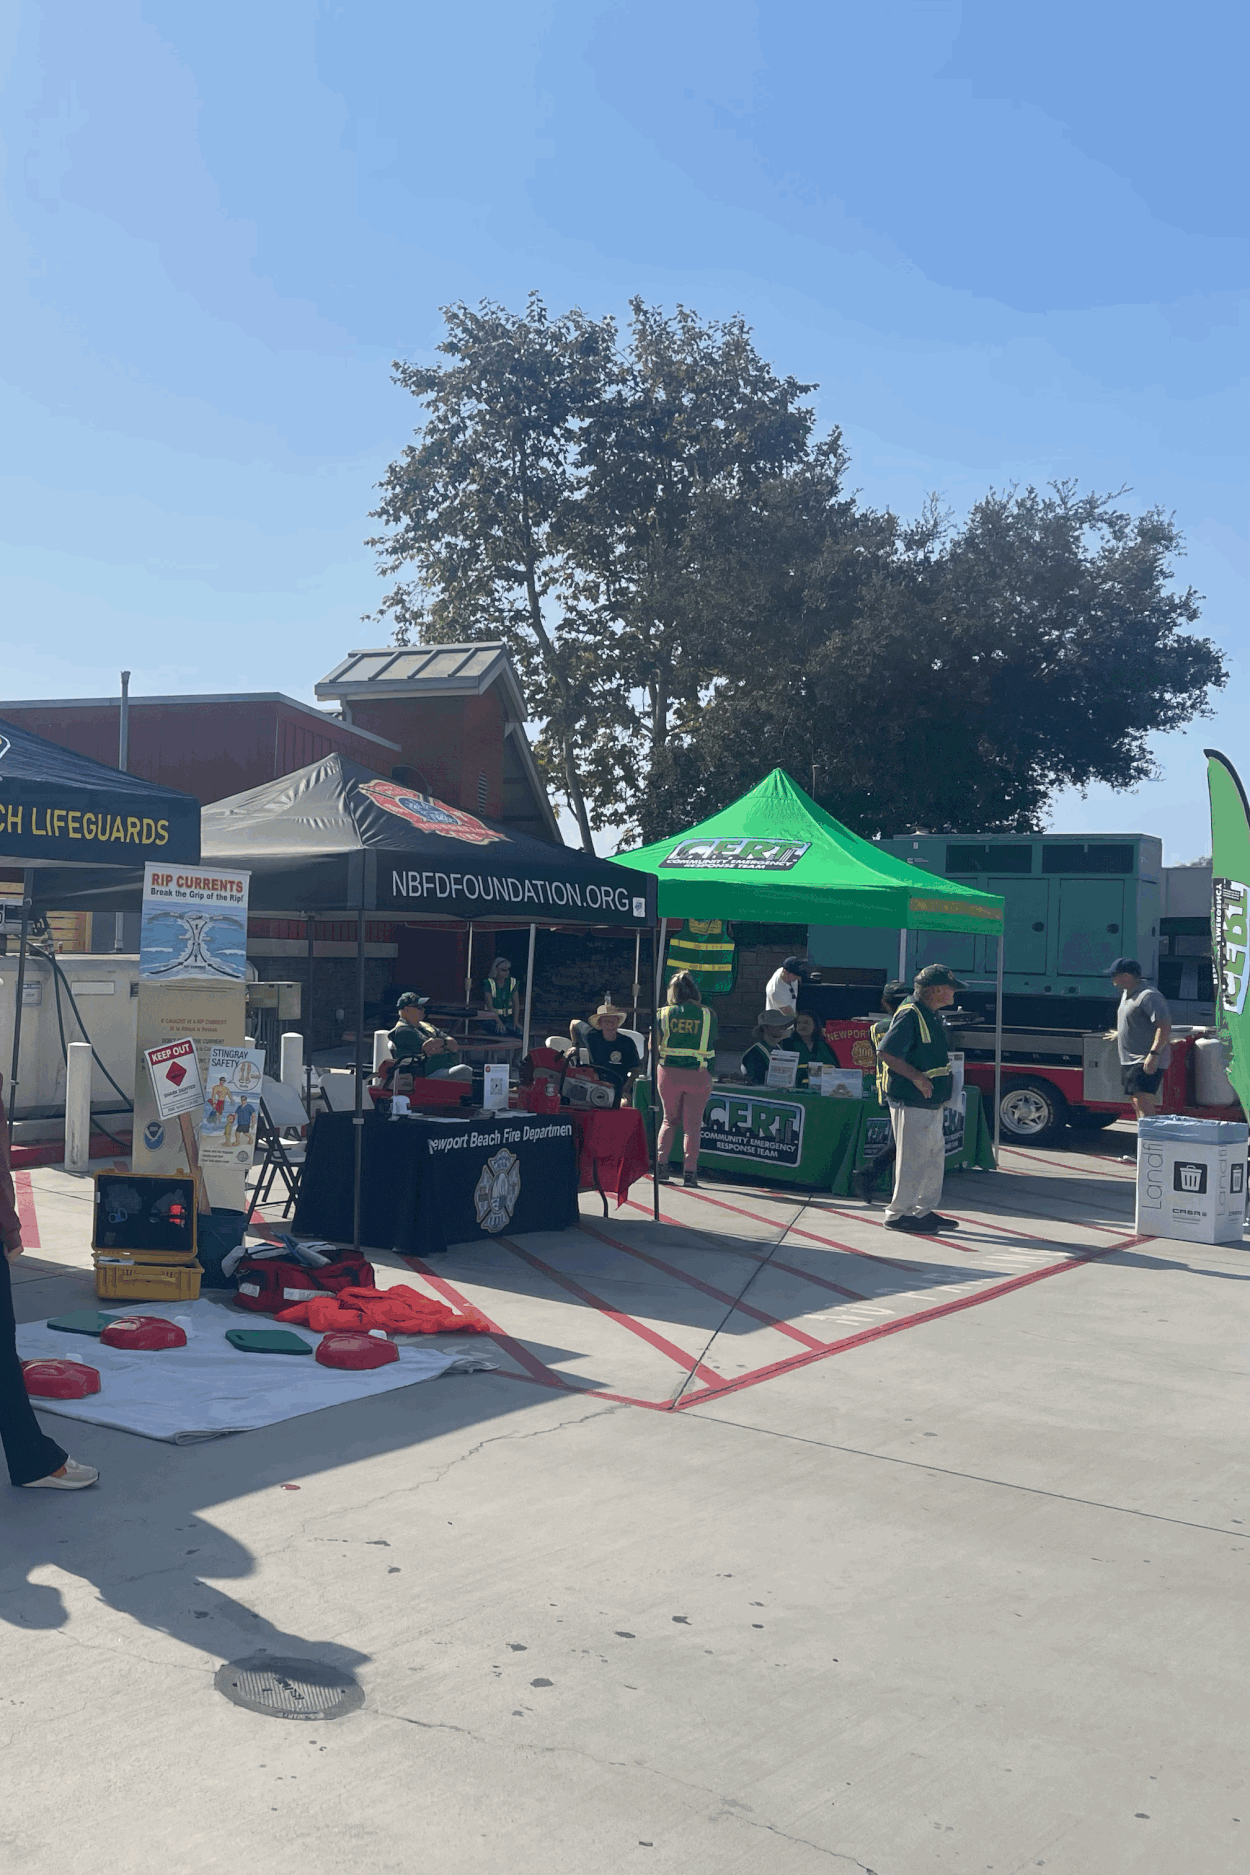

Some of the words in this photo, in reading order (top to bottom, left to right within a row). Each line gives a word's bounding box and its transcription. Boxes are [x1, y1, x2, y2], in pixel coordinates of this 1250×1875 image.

[31, 807, 169, 846] LIFEGUARDS
[676, 839, 806, 860] CERT
[730, 859, 794, 867] EMERGENCY
[151, 872, 174, 887] RIP
[176, 875, 244, 893] CURRENTS
[392, 870, 630, 912] NBFDFOUNDATION.ORG
[150, 887, 173, 897] Break
[175, 889, 187, 898] the
[189, 890, 205, 900] Grip
[206, 892, 214, 900] of
[216, 893, 228, 901] the
[670, 1018, 701, 1034] CERT
[151, 1049, 172, 1063] KEEP
[172, 1043, 190, 1056] OUT
[211, 1058, 240, 1068] SAFETY
[212, 1048, 249, 1060] STINGRAY
[702, 1098, 797, 1141] CERT
[470, 1129, 501, 1148] Beach
[502, 1127, 521, 1144] Fire
[522, 1123, 573, 1143] Departmen
[700, 1131, 748, 1143] COMMUNITY
[750, 1139, 797, 1153] EMERGENCY
[716, 1141, 756, 1154] RESPONSE
[757, 1147, 779, 1158] TEAM
[1141, 1136, 1164, 1210] Landfil
[1216, 1144, 1228, 1216] Landfil
